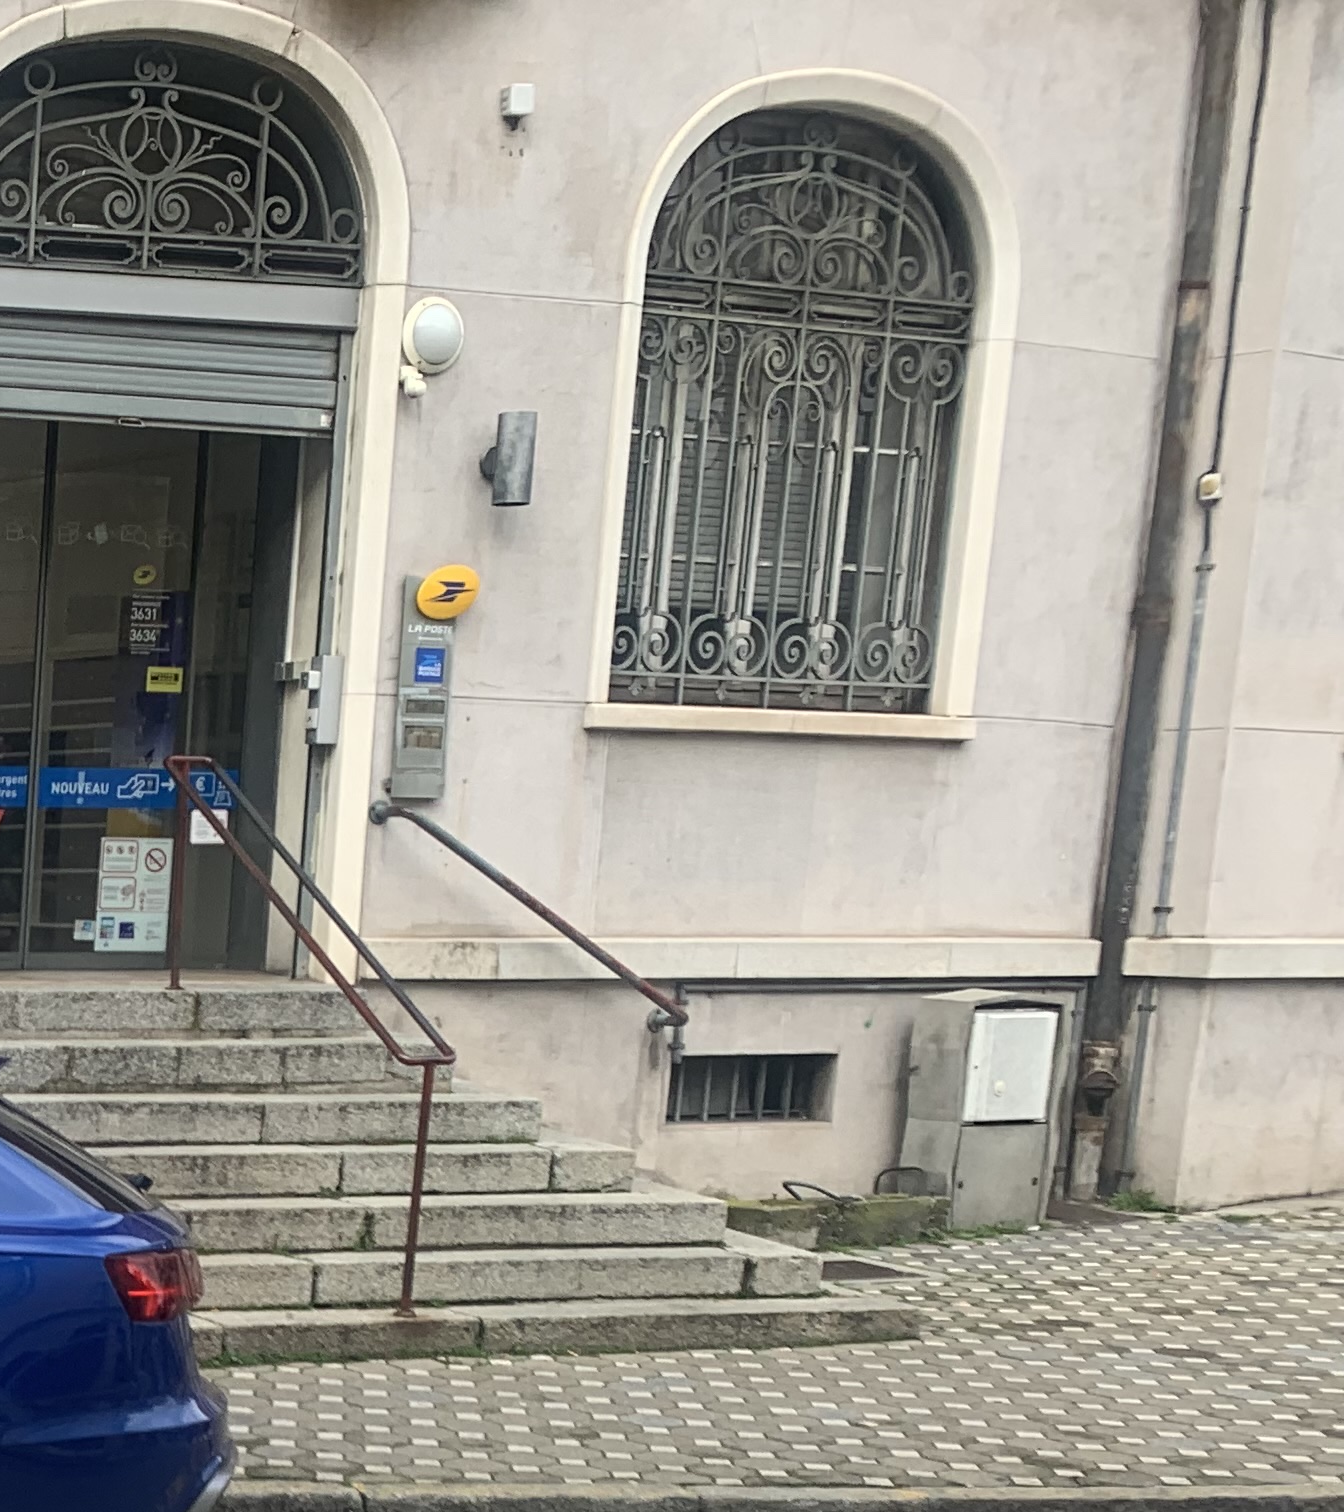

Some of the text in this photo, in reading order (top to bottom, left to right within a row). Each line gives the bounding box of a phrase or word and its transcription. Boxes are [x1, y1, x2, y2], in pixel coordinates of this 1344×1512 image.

[131, 607, 157, 620] 3631
[130, 628, 156, 641] 3634
[408, 624, 422, 633] LA
[51, 782, 109, 795] NOUVEAU
